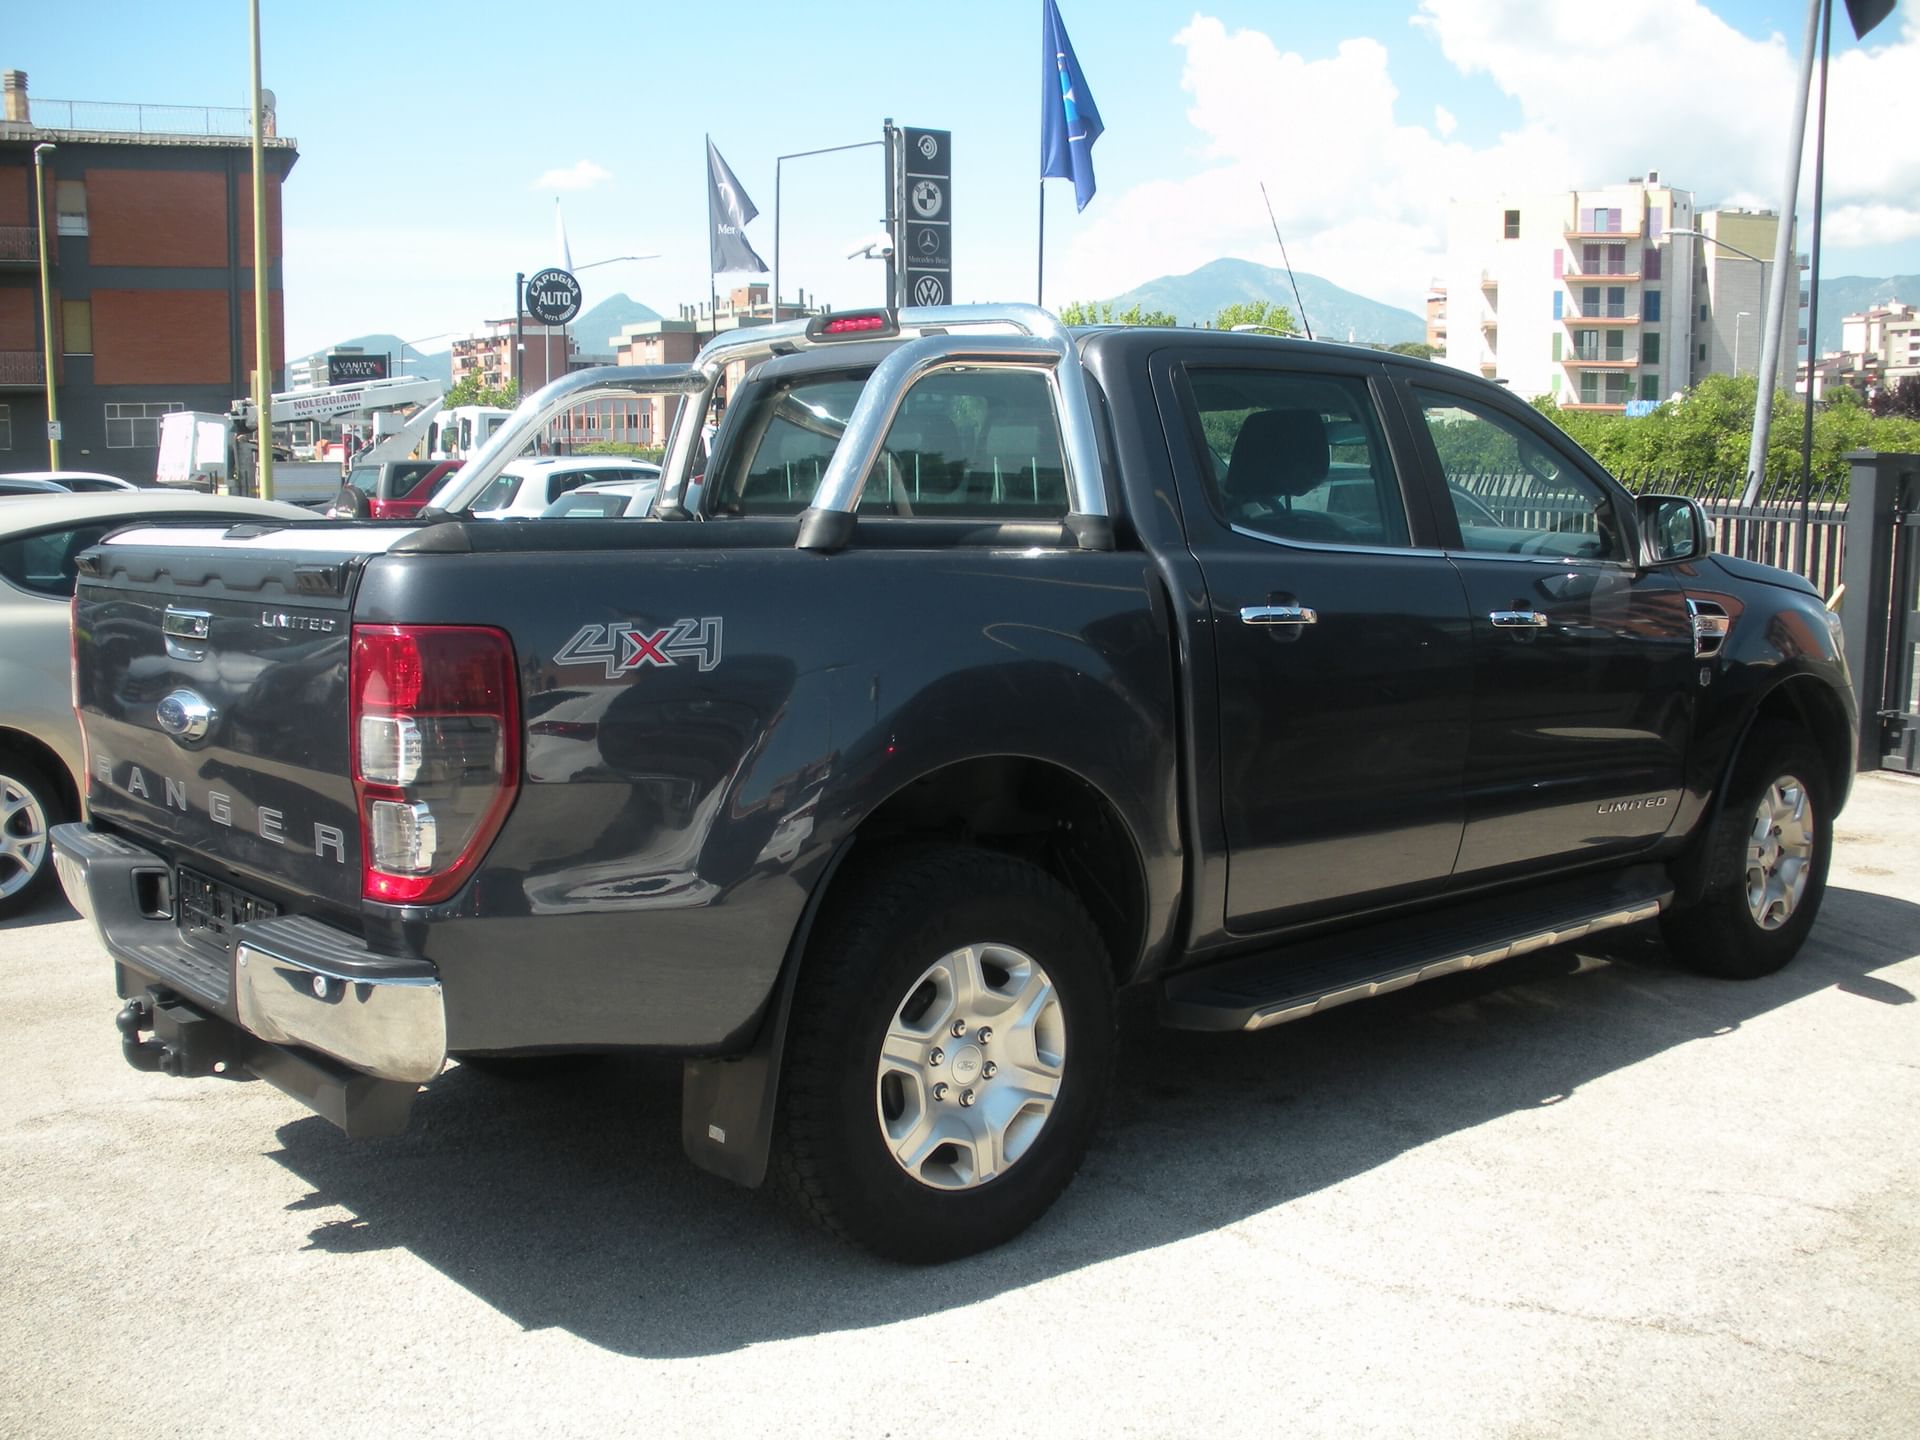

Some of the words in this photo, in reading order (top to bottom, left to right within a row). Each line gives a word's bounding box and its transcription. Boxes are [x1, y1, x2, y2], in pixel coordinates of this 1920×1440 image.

[531, 272, 579, 296] CAPOGNA
[538, 291, 572, 306] AUTO
[339, 361, 375, 369] VANITY
[293, 392, 361, 410] NOLEGGIAMI
[96, 753, 346, 864] RANGER
[1597, 796, 1668, 814] LIMITED
